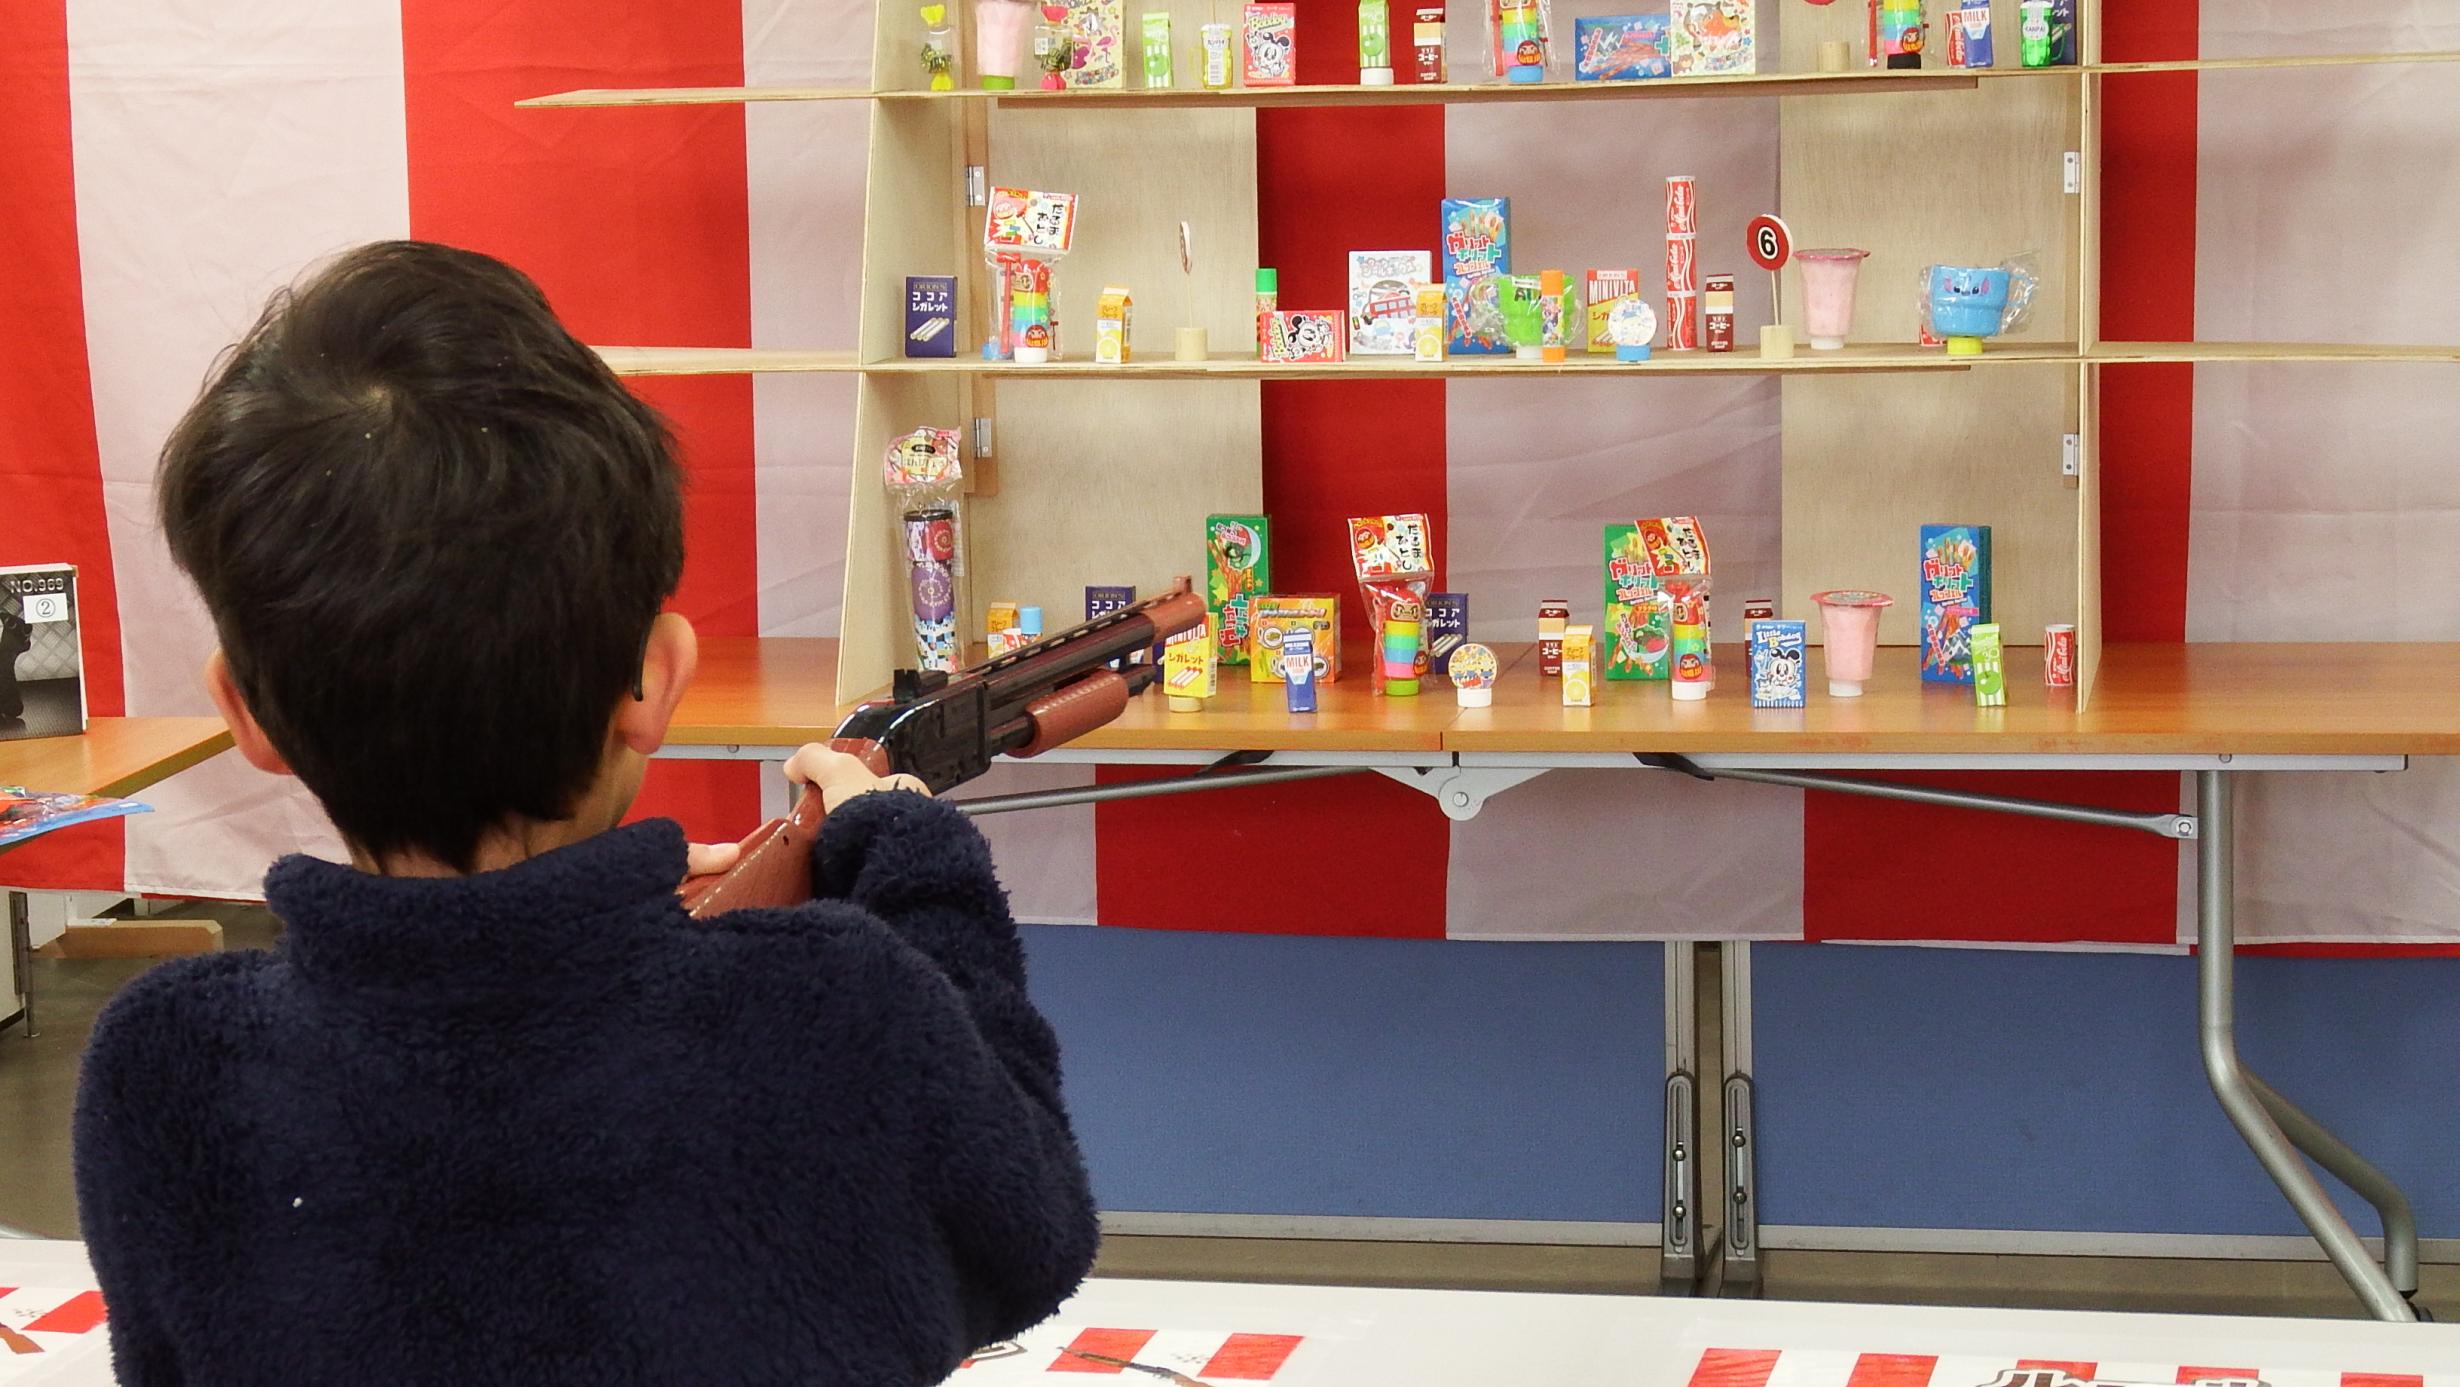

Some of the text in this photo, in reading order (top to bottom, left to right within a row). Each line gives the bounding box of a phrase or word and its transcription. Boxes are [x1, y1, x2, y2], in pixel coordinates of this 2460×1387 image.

[1964, 10, 1987, 22] MILK
[1760, 229, 1776, 257] 6
[912, 291, 949, 302] ココア
[912, 302, 949, 313] シガレット
[10, 578, 64, 593] NO.969
[1091, 600, 1126, 610] ココア
[1425, 608, 1460, 618] ココア
[1168, 652, 1204, 665] シガレット
[1286, 656, 1310, 669] MILK
